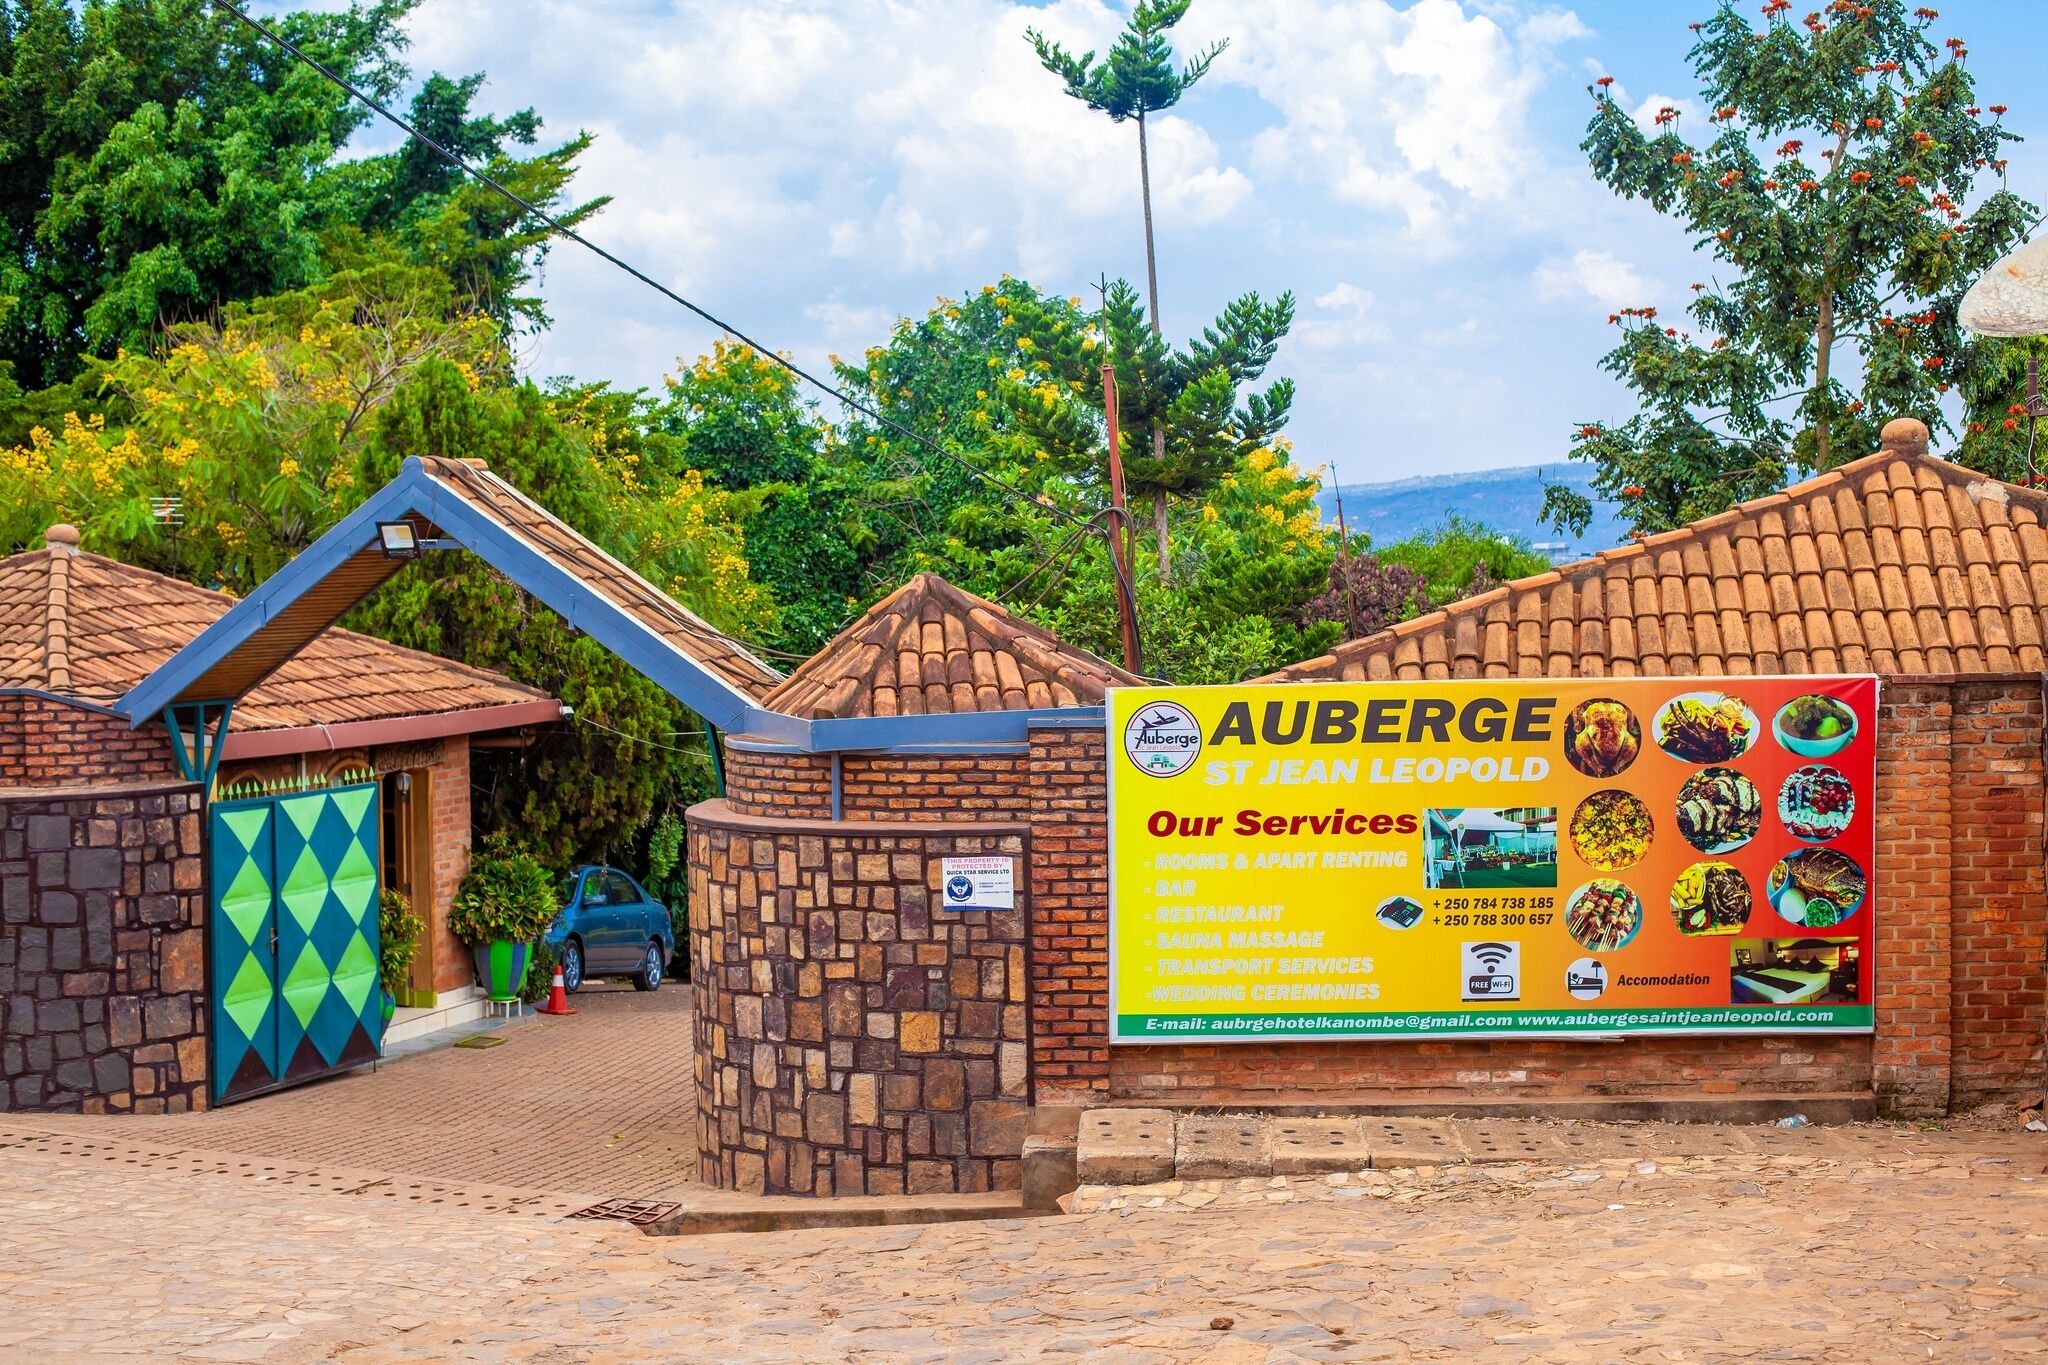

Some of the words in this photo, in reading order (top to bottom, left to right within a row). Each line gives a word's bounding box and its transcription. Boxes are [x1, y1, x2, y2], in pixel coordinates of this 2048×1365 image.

[1208, 697, 1557, 745] AUBERGE
[1135, 729, 1198, 750] Auberge
[1203, 760, 1254, 786] ST
[1259, 758, 1359, 786] JEAN
[1369, 756, 1550, 784] LEOPOLD
[1147, 810, 1223, 837] Our
[1233, 808, 1418, 836] Services
[1154, 853, 1229, 871] ROOMS
[1233, 852, 1249, 870] &
[1253, 851, 1318, 869] APART
[1321, 850, 1408, 868] RENTING
[1155, 879, 1197, 896] BAR
[1444, 898, 1469, 910] 250
[1473, 898, 1497, 909] 784
[1501, 897, 1526, 909] 738
[1529, 897, 1554, 909] 185
[1155, 904, 1284, 923] RESTAURANT
[1444, 914, 1469, 926] 250
[1473, 914, 1497, 926] 788
[1500, 914, 1525, 925] 300
[1529, 913, 1554, 925] 657
[1155, 932, 1222, 949] SAUNA
[1228, 931, 1325, 949] MASSAGE
[1157, 957, 1274, 976] TRANSPORT
[1277, 957, 1374, 975] SERVICES
[1471, 981, 1489, 989] FREE
[1492, 980, 1511, 988] Wi-Fi
[1617, 972, 1710, 986] Accomodation
[1251, 983, 1380, 1001] CEREMONIES
[1146, 1017, 1206, 1030] E-mail:
[1211, 1014, 1513, 1032] aubrgehotelkanombe@gmail.com
[1518, 1010, 1833, 1027] www.aubergesaintjeanleopold.com
